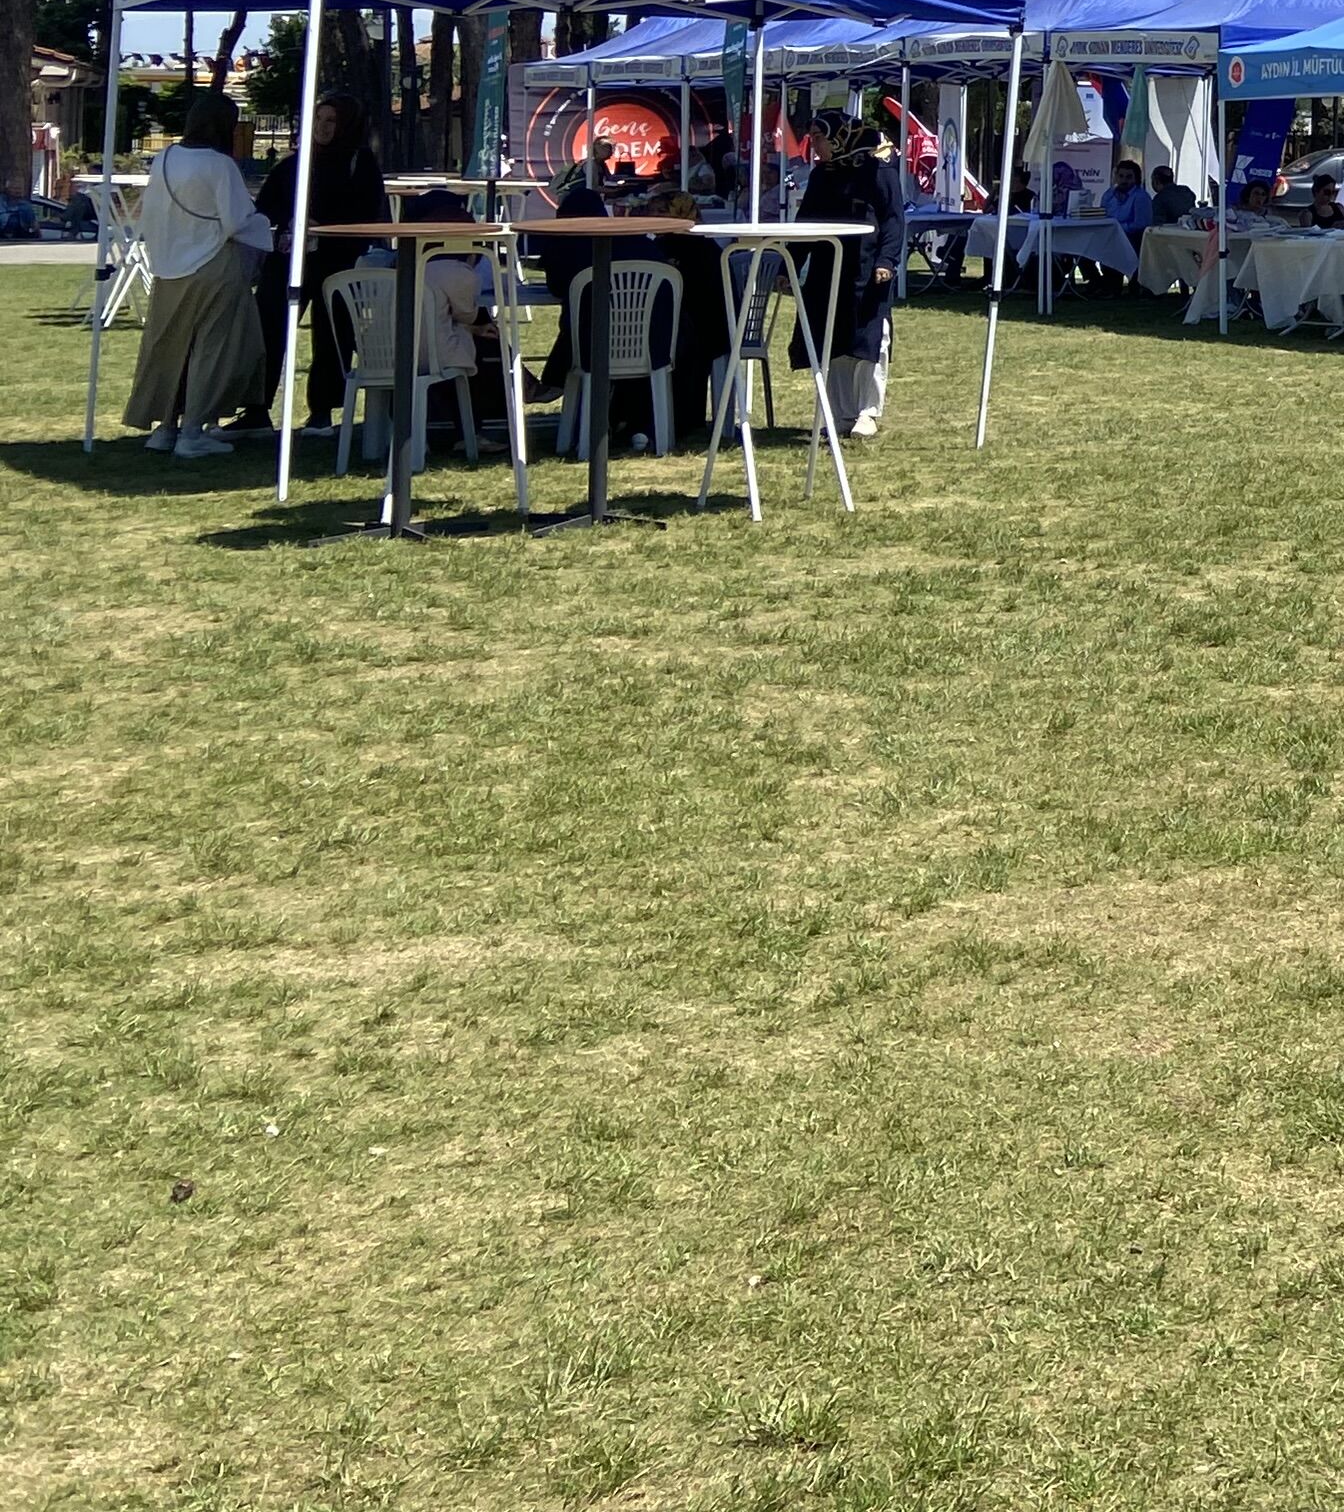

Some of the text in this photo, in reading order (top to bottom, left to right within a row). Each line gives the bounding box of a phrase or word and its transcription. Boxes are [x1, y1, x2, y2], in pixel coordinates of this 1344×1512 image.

[1261, 61, 1291, 80] AYDIN
[1291, 56, 1301, 78] İL
[593, 117, 653, 138] Genç
